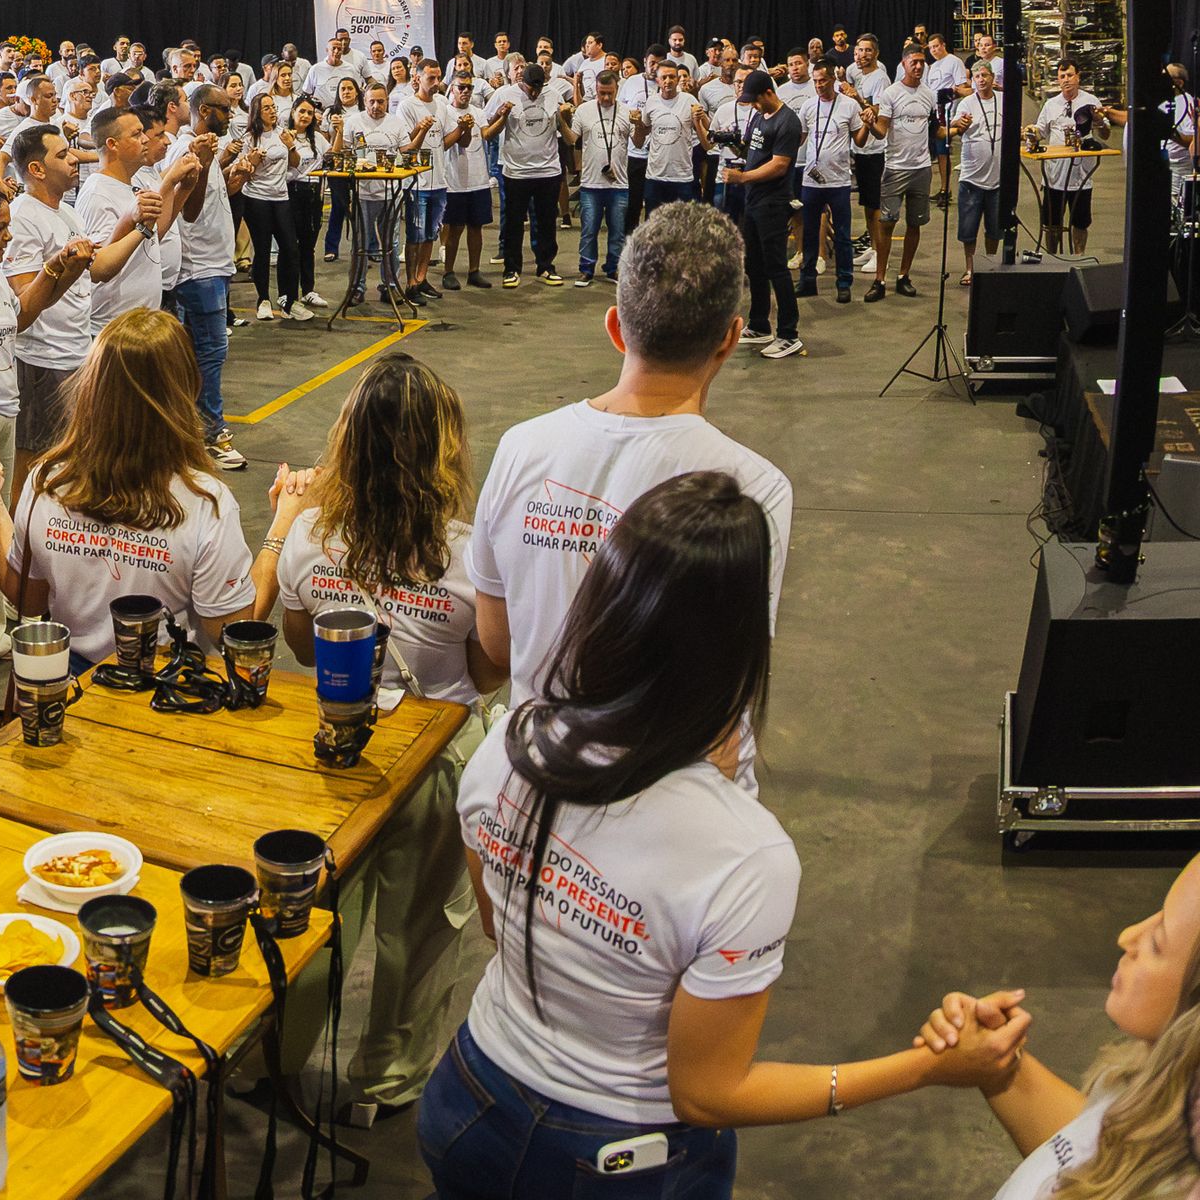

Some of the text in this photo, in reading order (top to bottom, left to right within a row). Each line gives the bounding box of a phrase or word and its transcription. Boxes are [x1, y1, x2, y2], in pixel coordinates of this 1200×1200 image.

[350, 16, 395, 24] FUNDIMIG
[389, 32, 409, 57] FUTURO
[524, 516, 566, 537] FORÇA
[570, 523, 594, 538] NO
[527, 501, 584, 519] ORGULHO
[587, 508, 604, 522] DO
[47, 528, 175, 565] FORÇA NO PRESENTE,
[48, 516, 170, 551] ORGULHO DO PASSADO,
[523, 532, 598, 553] OLHAR PARA
[45, 541, 170, 573] OLHAR PARA O FUTURO.
[311, 589, 451, 623] OLHAR PAA O FUTURO.
[312, 576, 353, 593] FORÇA
[381, 587, 455, 614] PRESENTE,
[548, 849, 572, 872] DO
[573, 863, 644, 921] PASSADO,
[556, 875, 651, 942] PRESENTE,
[558, 899, 570, 915] O
[571, 909, 643, 956] FUTURO.
